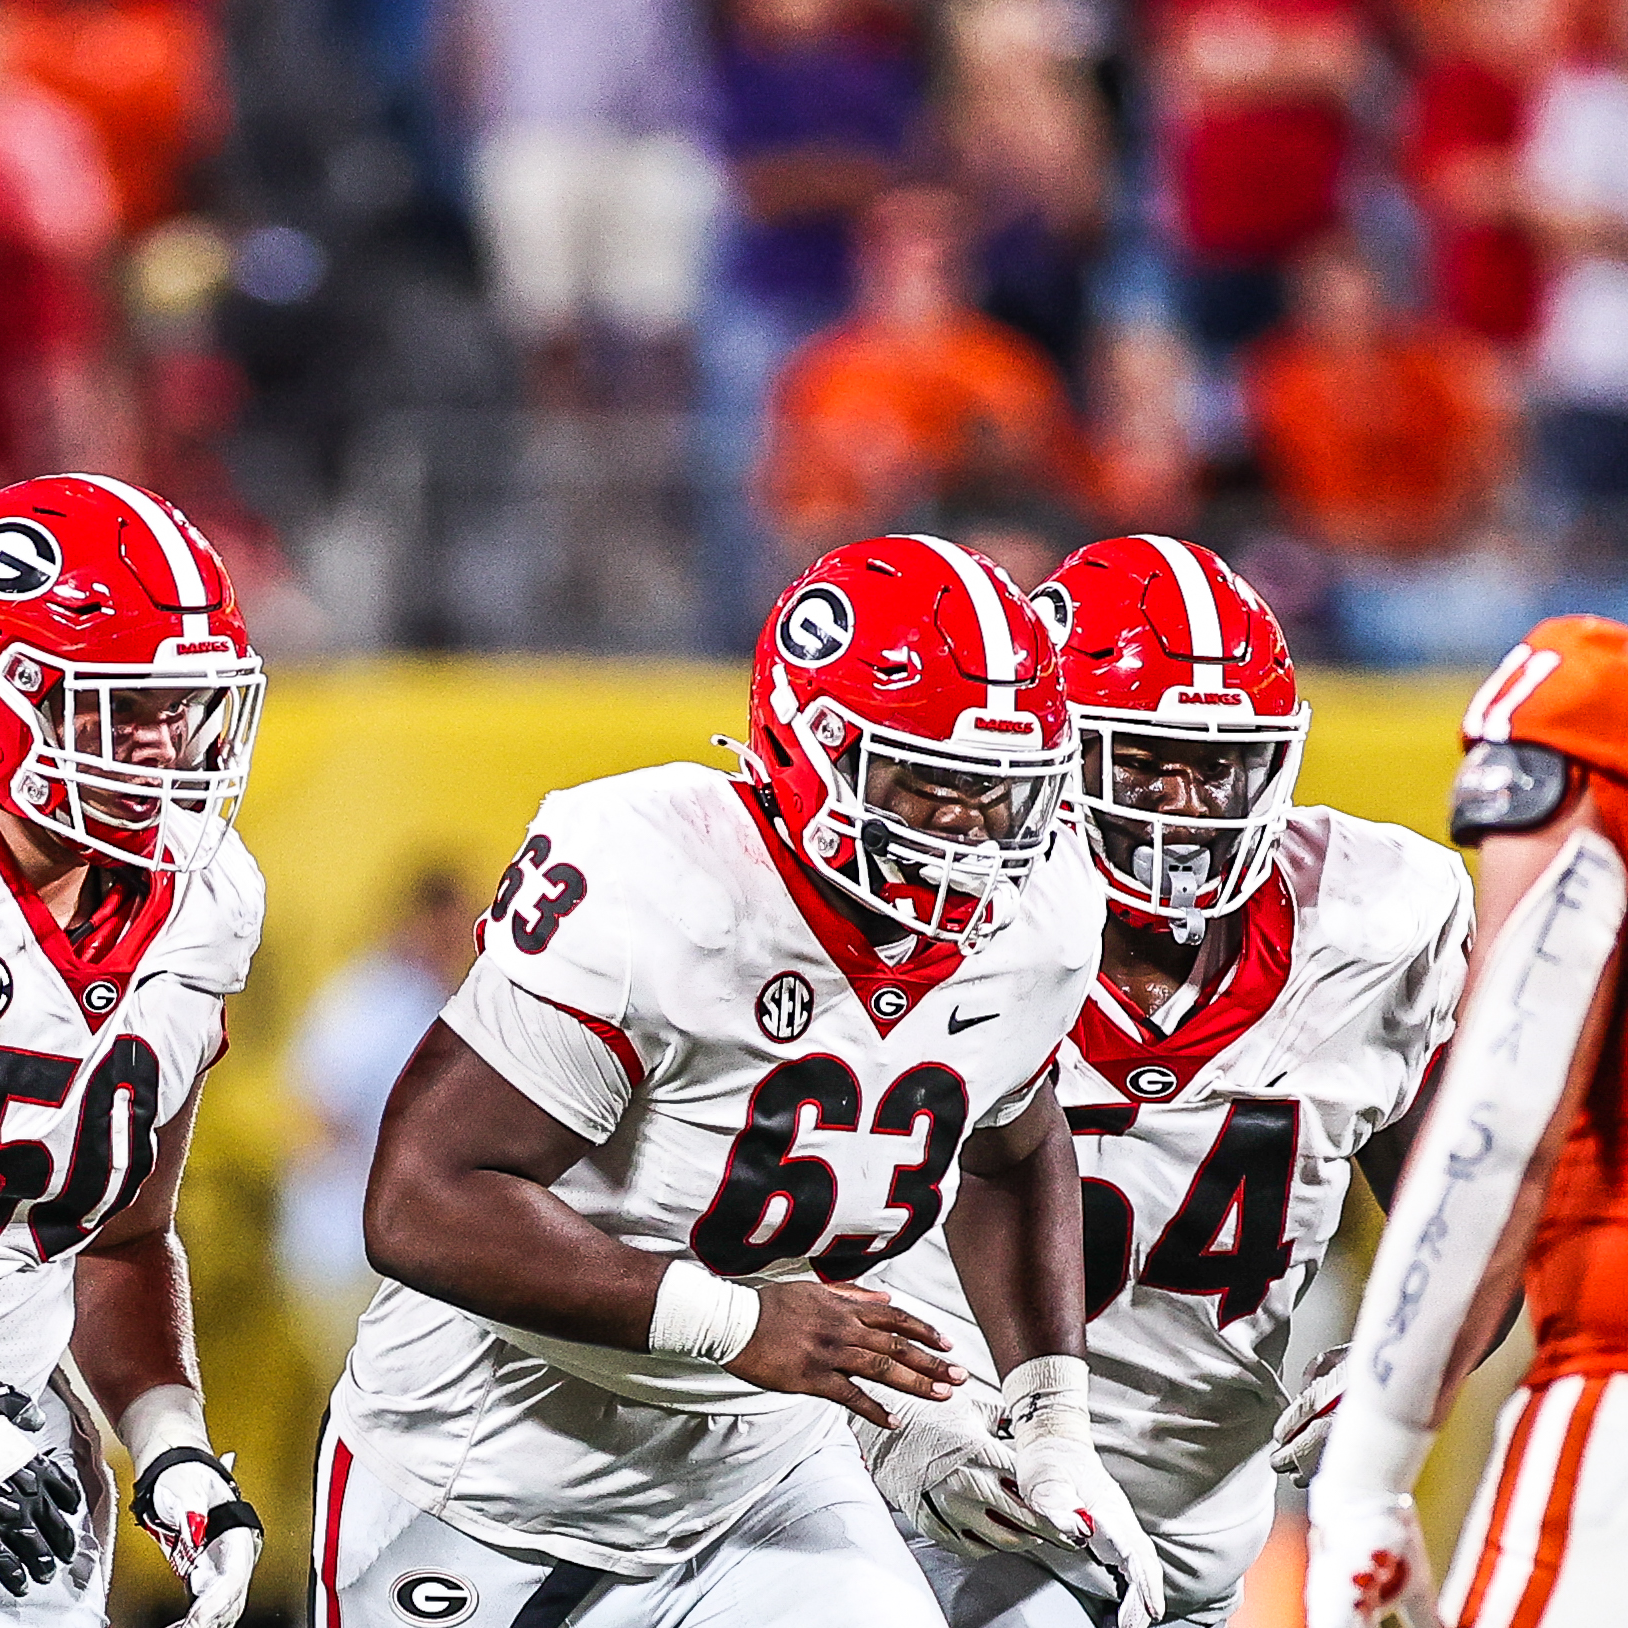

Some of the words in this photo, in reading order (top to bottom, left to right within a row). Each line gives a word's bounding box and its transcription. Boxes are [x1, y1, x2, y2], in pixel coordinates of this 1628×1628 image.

[779, 587, 851, 663] G
[1177, 691, 1242, 706] DAWGS
[1462, 642, 1562, 744] 11
[490, 833, 588, 955] 63
[84, 981, 117, 1013] G
[760, 974, 812, 1039] SEC
[871, 985, 908, 1020] G
[1127, 1067, 1176, 1098] G
[690, 1052, 970, 1284] 63
[393, 1574, 470, 1622] G
